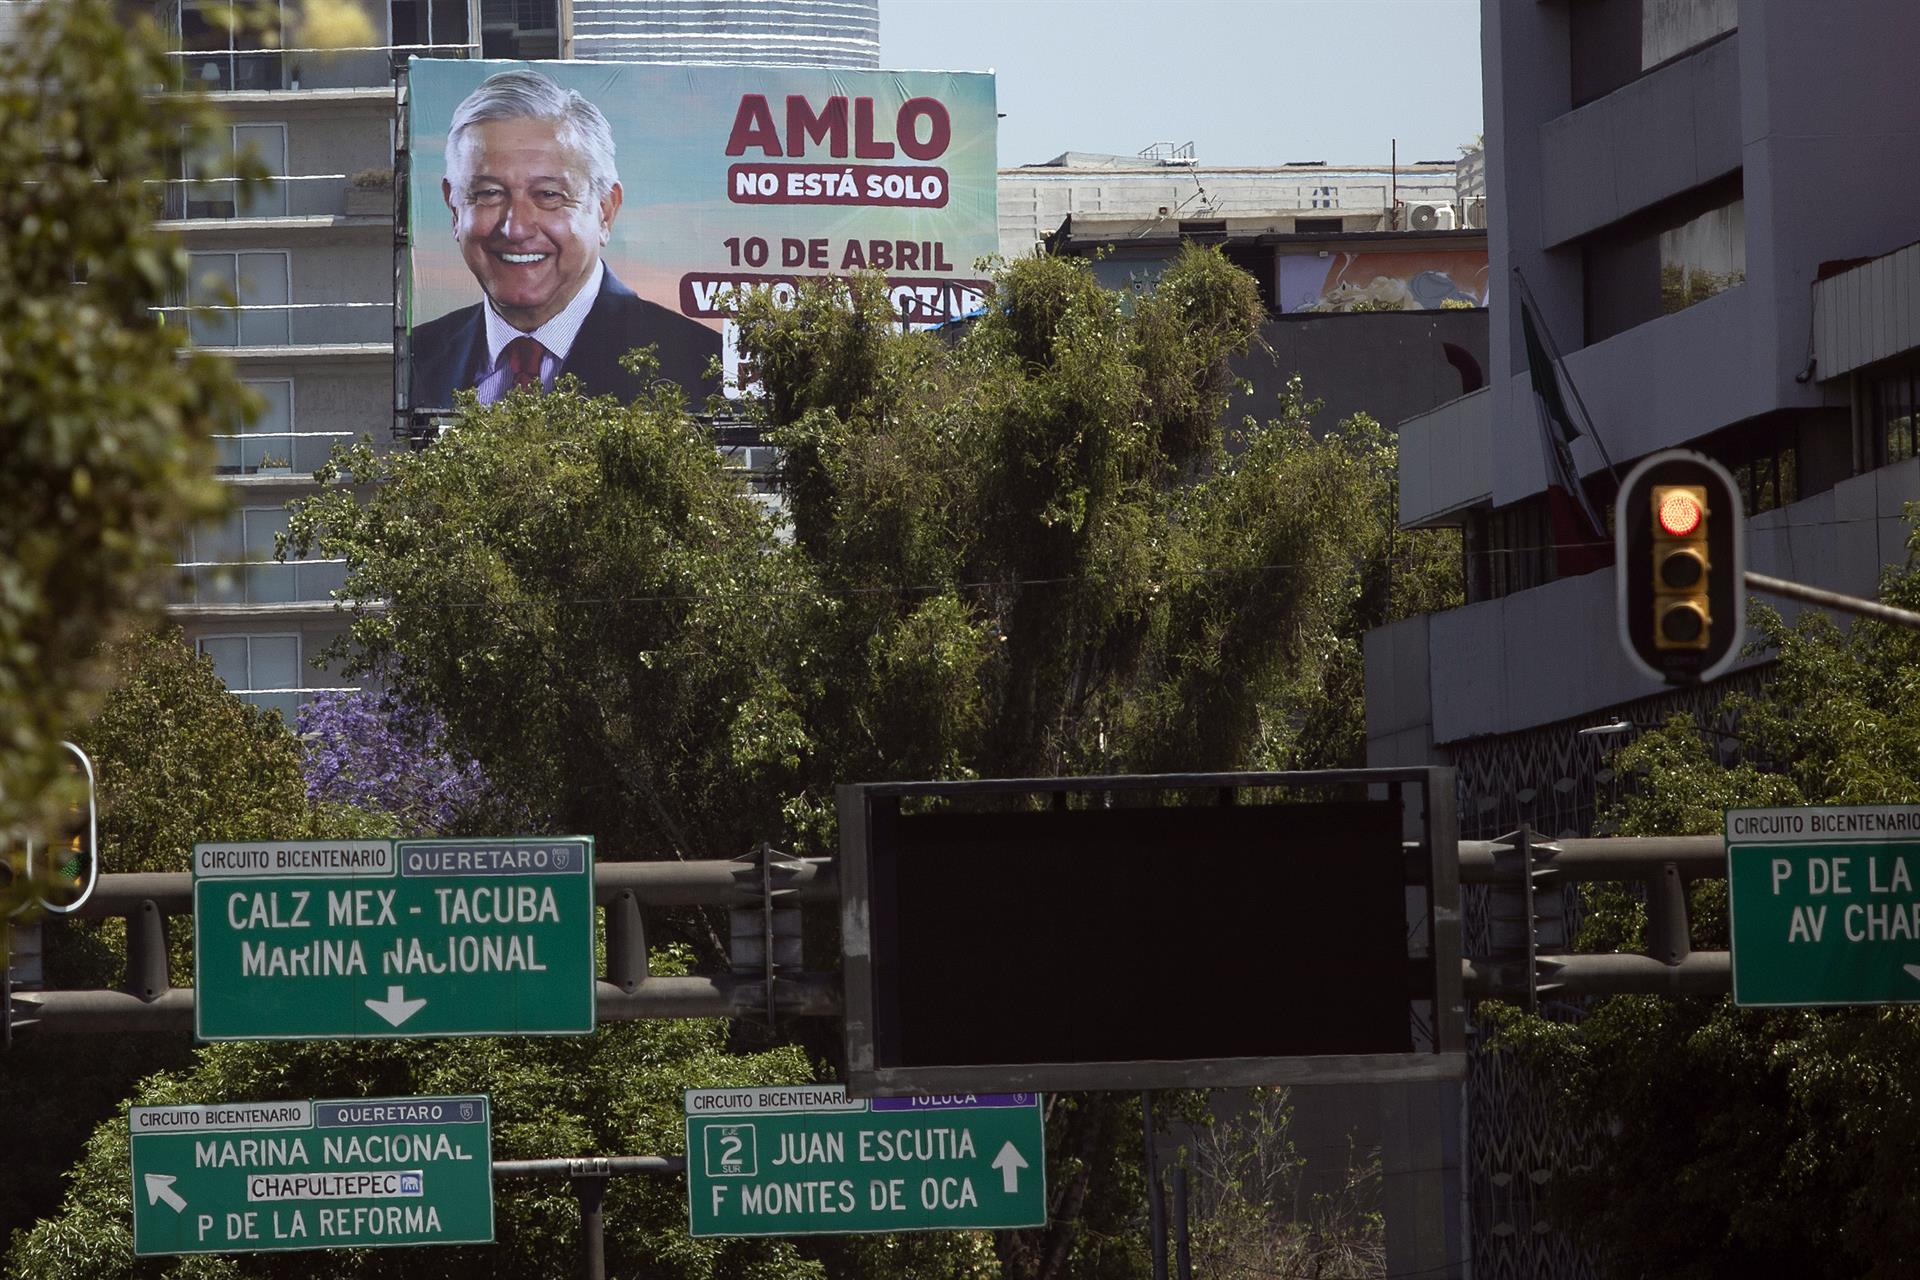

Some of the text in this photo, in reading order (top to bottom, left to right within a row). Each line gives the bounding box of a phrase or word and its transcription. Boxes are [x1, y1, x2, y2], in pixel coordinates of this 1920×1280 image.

[725, 94, 951, 161] AMLO
[736, 168, 943, 200] NO ESTÁ SOLO
[723, 236, 953, 272] 10 DE ABRIL
[691, 281, 808, 312] VAO
[878, 285, 988, 318] OTAR
[1734, 812, 1920, 835] CIRCUITO BICENTENARIO
[201, 848, 386, 869] CIRCUITO BICENTENARIO
[408, 850, 548, 872] QUERETARO
[1771, 856, 1913, 895] P DE LA
[227, 891, 311, 930] CALZ
[327, 889, 398, 926] MEX
[434, 886, 560, 924] TACUBA
[1788, 905, 1827, 943] AV
[241, 940, 367, 976] MARINA
[140, 1107, 301, 1127] CIRCUITO BICENTENARIO
[337, 1105, 443, 1122] QUERETARO
[694, 1094, 753, 1110] CIRCUITO
[195, 1134, 473, 1168] MARINA NACIONAL
[720, 1136, 743, 1165] 2
[772, 1128, 977, 1166] JUAN ESCUTIA
[251, 1175, 397, 1198] CHAPULTEPEC
[712, 1177, 978, 1216] F MONTES DE OCA
[198, 1206, 442, 1241] P DE LA REFORMA
